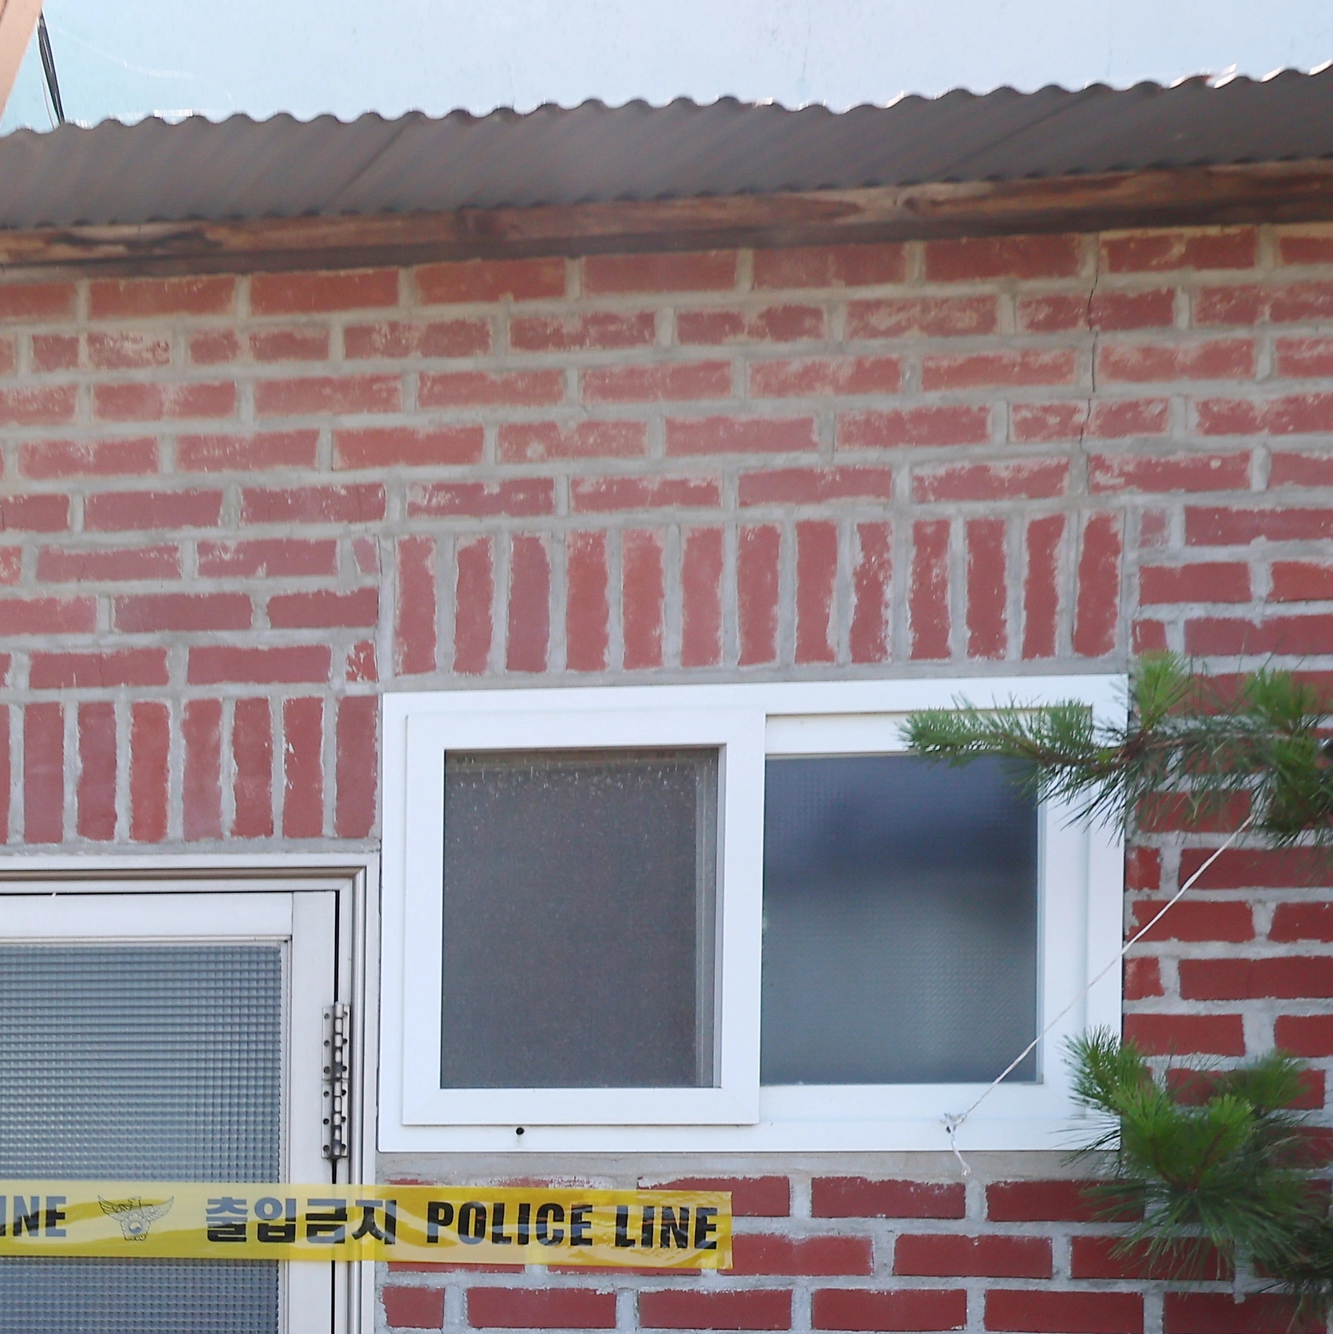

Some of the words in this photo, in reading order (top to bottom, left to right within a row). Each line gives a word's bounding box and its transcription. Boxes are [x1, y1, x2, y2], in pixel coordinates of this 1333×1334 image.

[206, 1195, 396, 1245] 출입금지
[426, 1201, 593, 1248] POLICE
[614, 1204, 718, 1250] LINE
